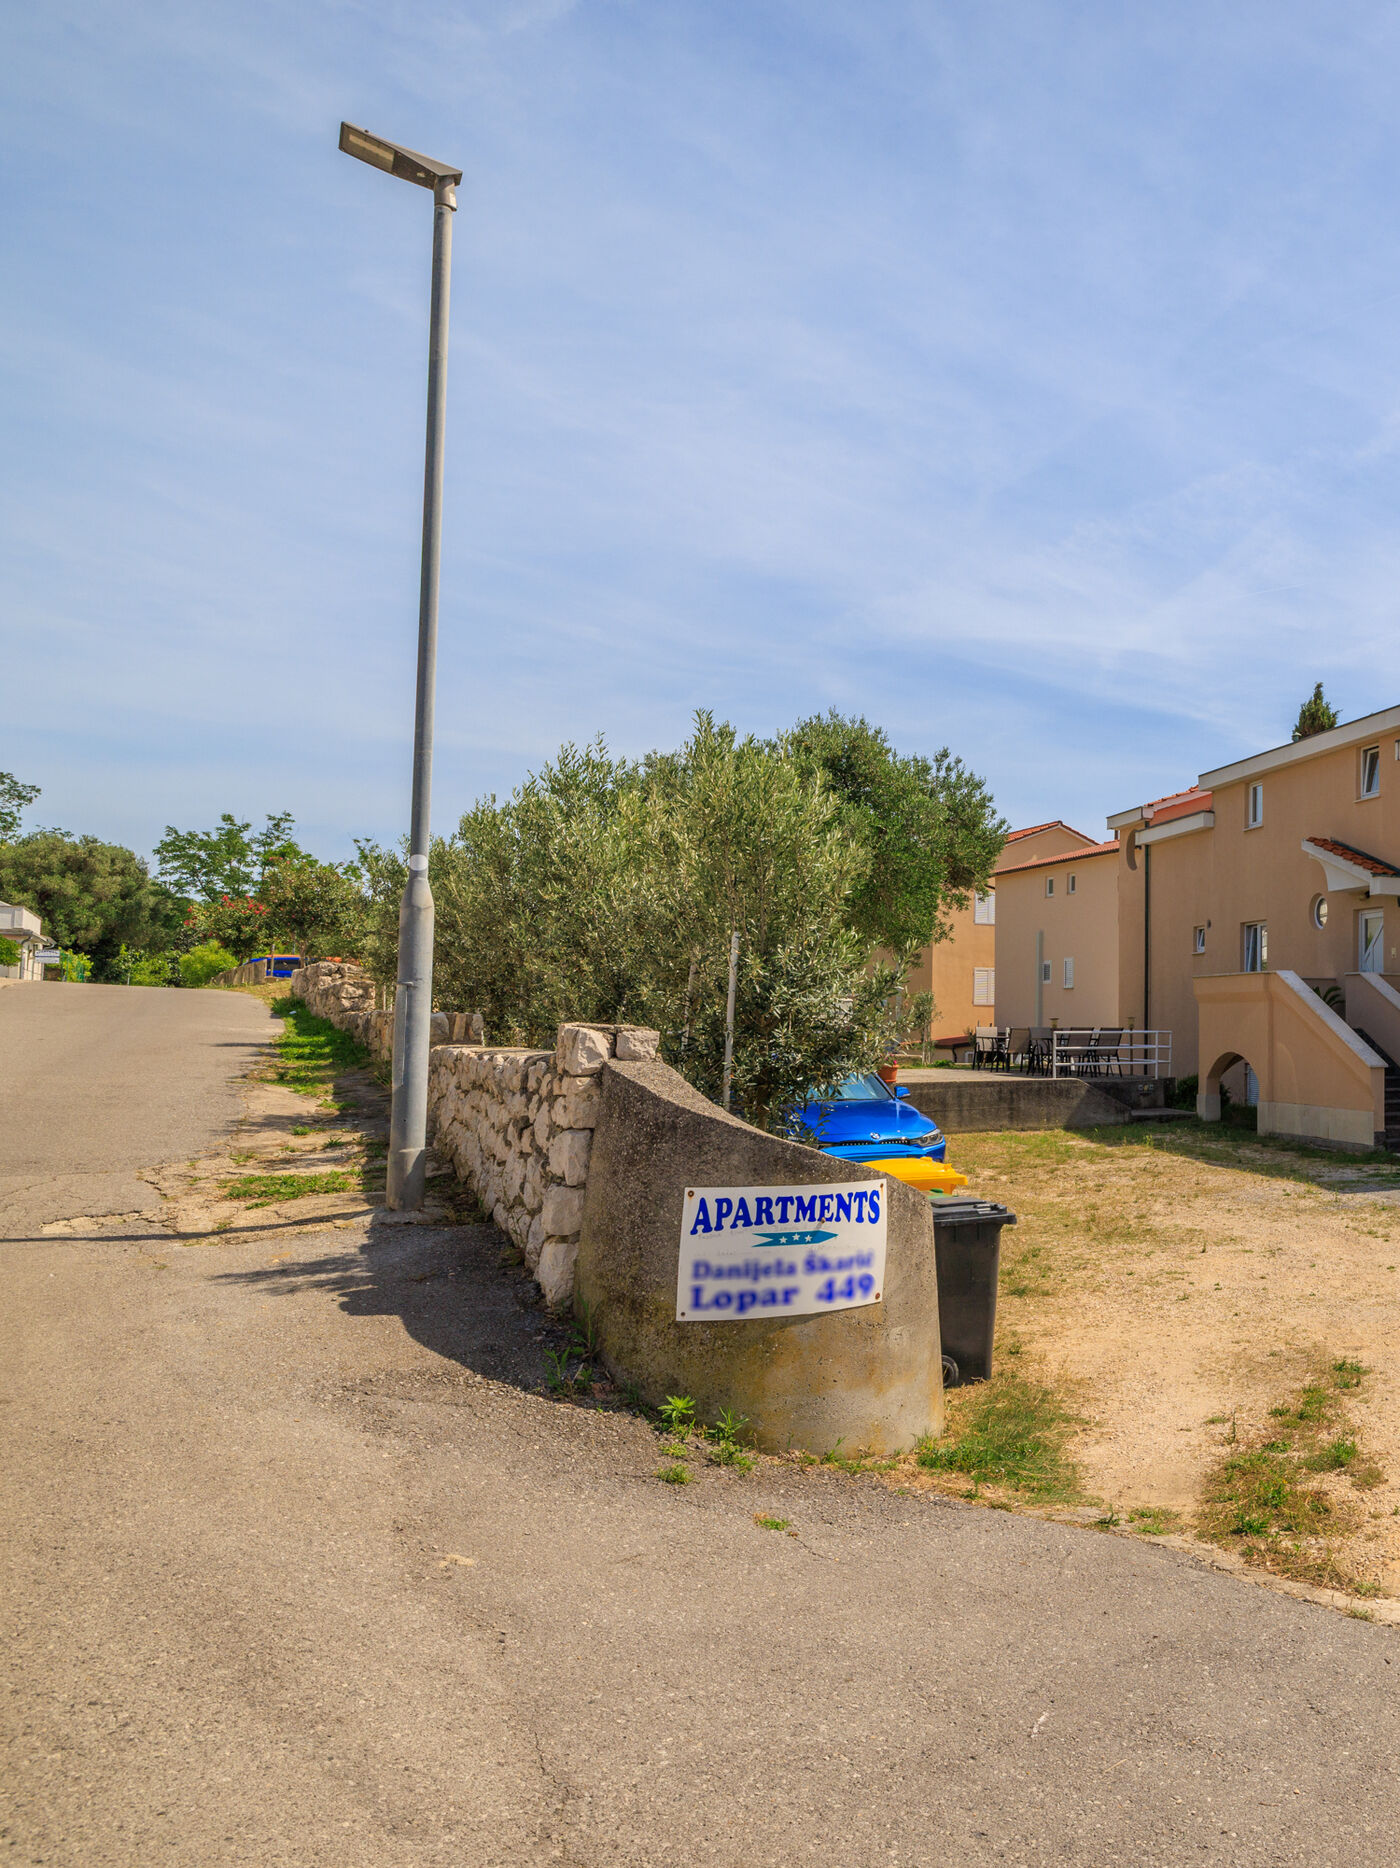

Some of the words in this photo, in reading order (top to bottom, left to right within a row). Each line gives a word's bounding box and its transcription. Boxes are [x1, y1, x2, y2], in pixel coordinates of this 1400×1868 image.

[690, 1190, 880, 1235] APARTMENTS
[691, 1284, 799, 1313] Lopar
[816, 1273, 874, 1303] 449
